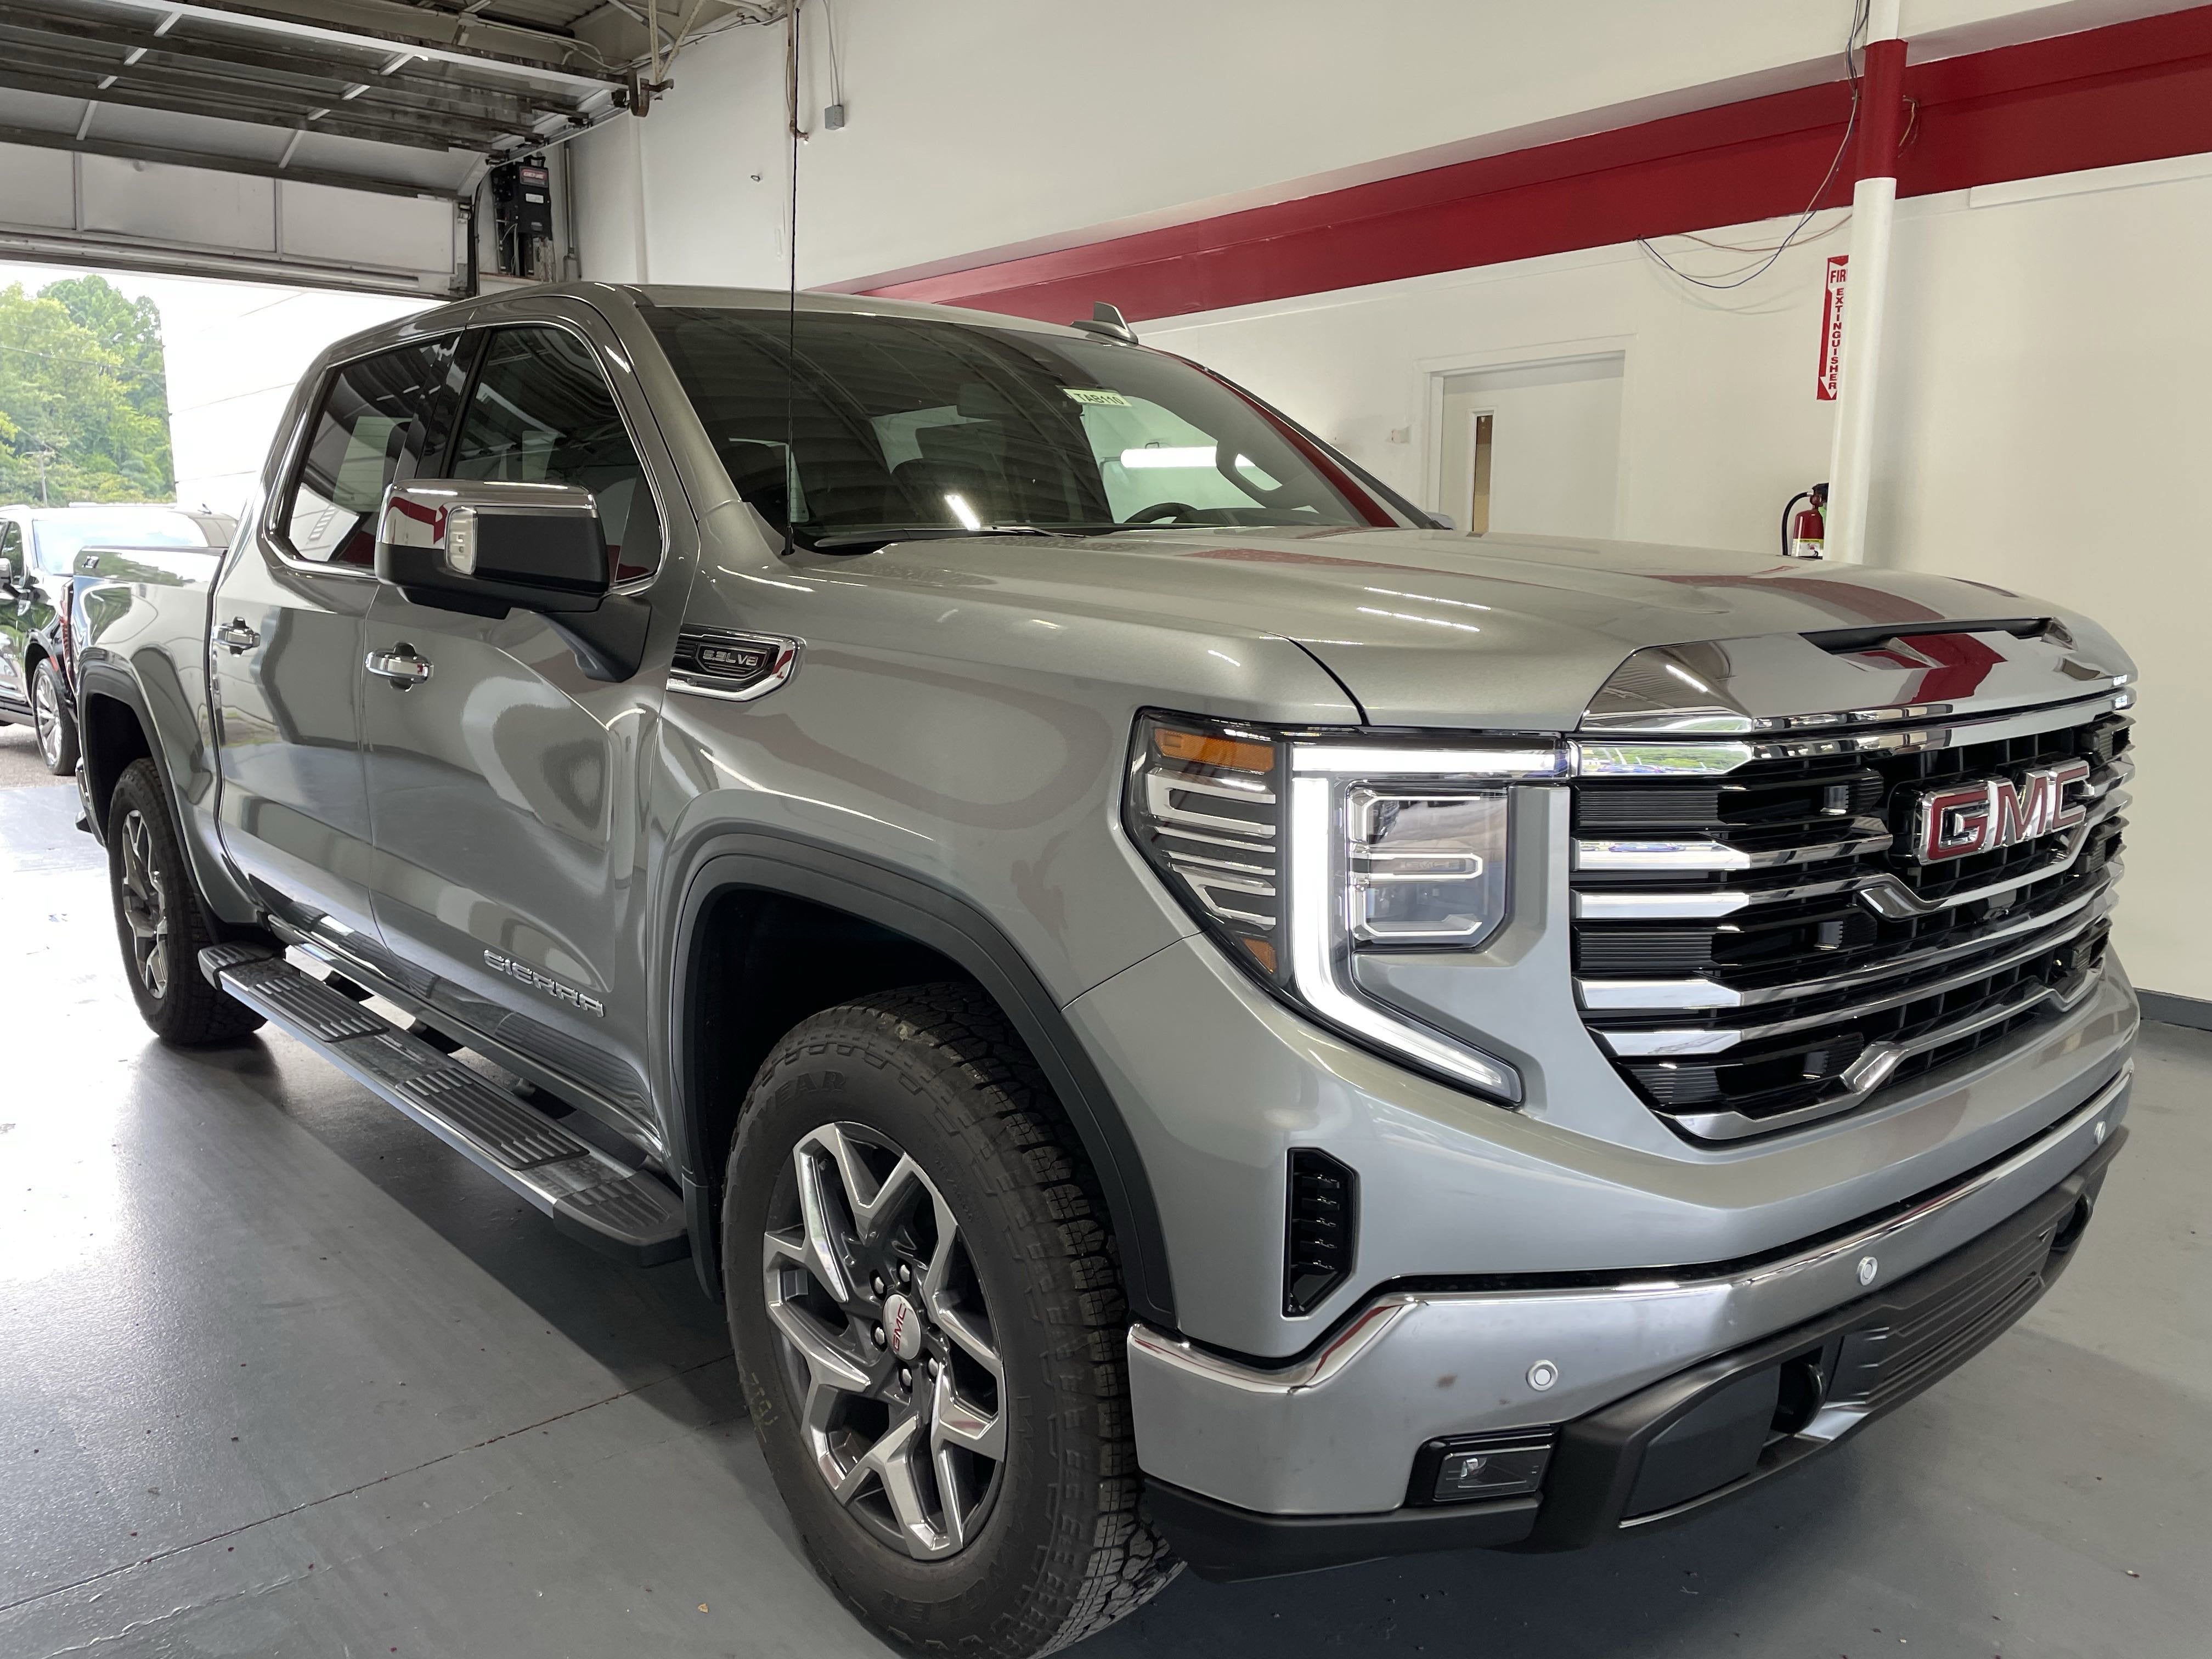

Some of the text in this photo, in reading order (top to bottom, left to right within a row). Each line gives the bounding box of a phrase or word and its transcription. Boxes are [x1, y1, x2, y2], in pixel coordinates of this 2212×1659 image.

[1830, 269, 1848, 283] FIR
[1829, 287, 1844, 390] EXTINGUISHER
[1073, 393, 1124, 405] TAB110
[737, 654, 759, 666] V8
[1919, 760, 2090, 865] GMC
[483, 949, 605, 1018] SIERRA
[893, 1302, 907, 1352] GMC
